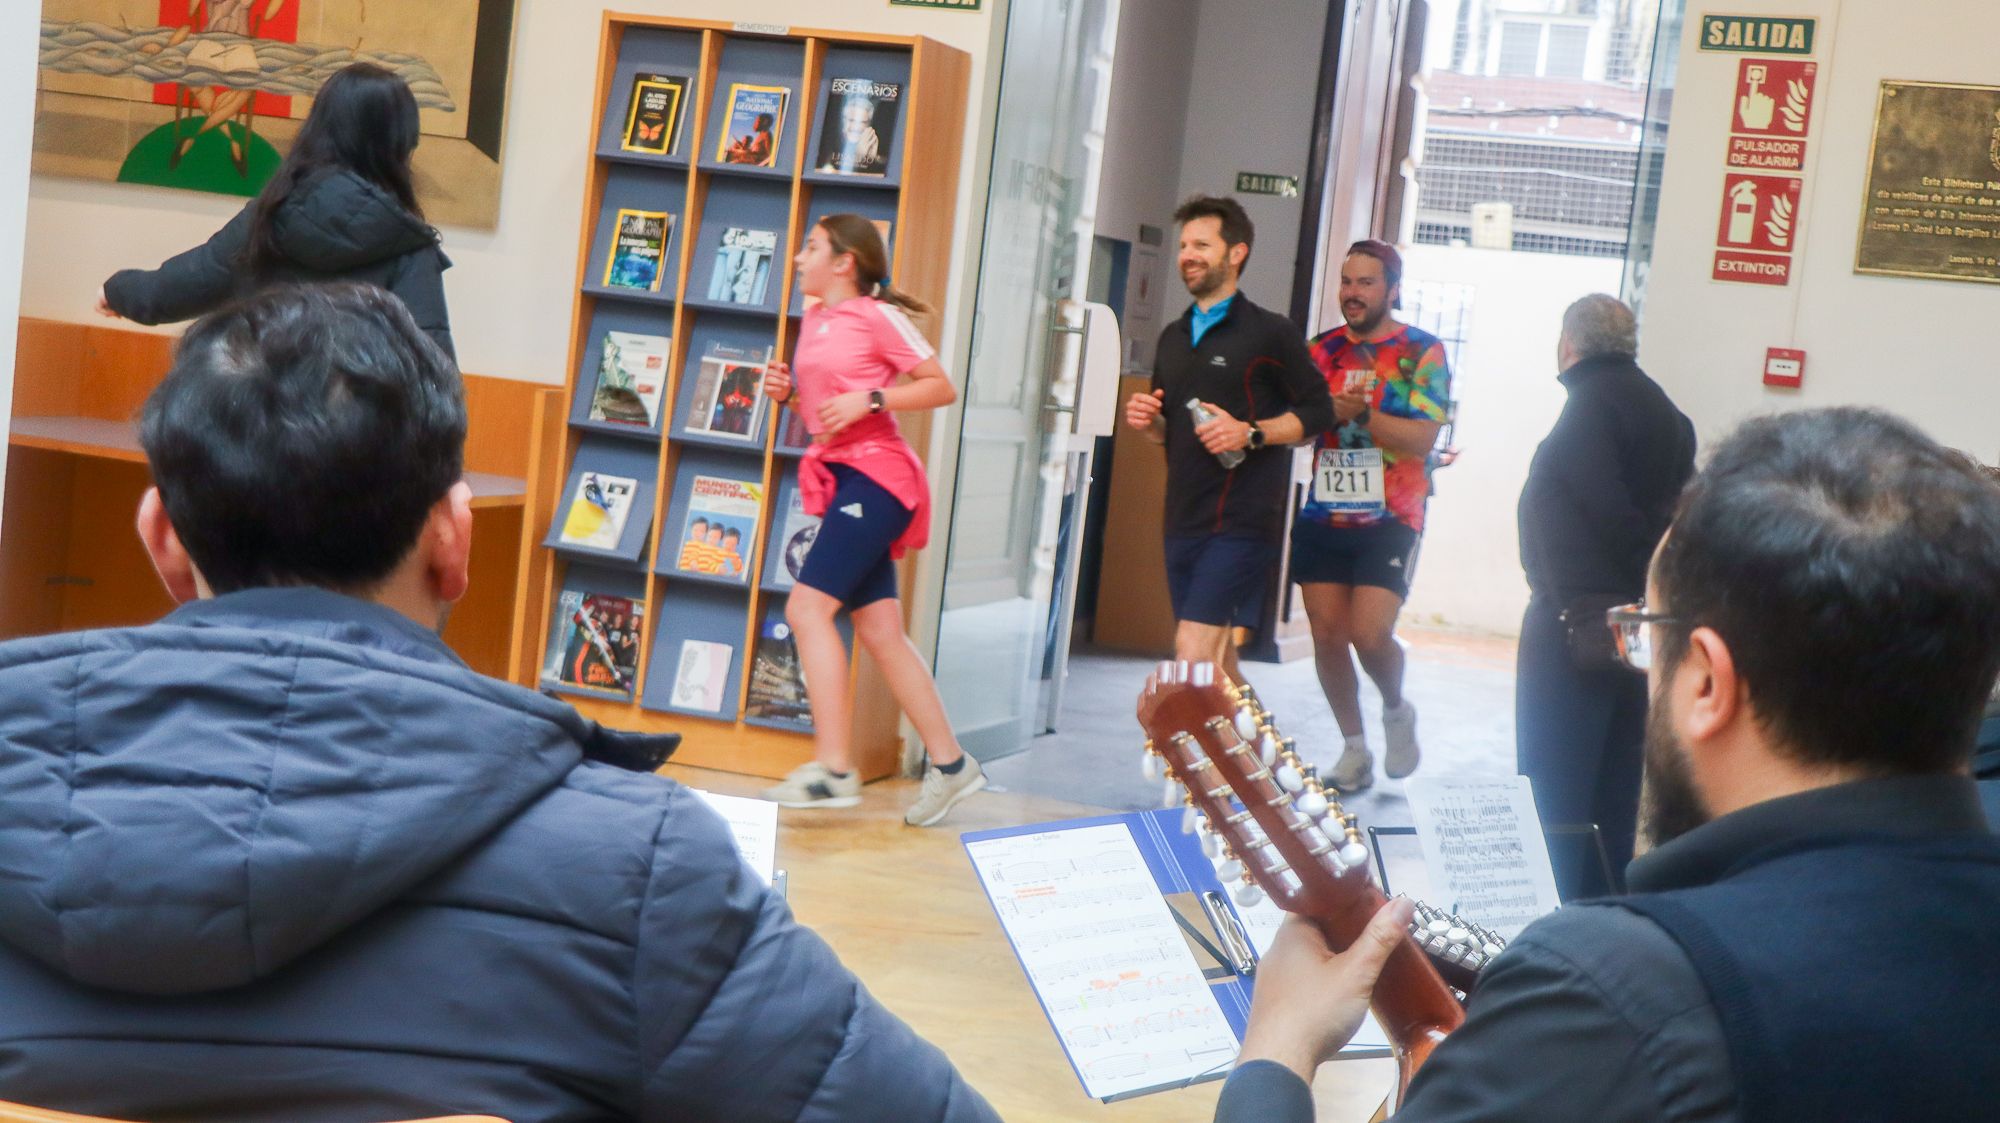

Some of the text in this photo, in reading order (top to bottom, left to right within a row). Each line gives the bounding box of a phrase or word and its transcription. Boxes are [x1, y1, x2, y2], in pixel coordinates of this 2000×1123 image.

[737, 22, 787, 33] HEMEROTECA
[1708, 20, 1805, 49] SALIDA
[832, 81, 898, 98] ESCENARIOS
[735, 101, 777, 113] GEOGRAPHIC
[746, 96, 773, 105] NATIONAL
[1734, 139, 1800, 154] PULSADOR
[1730, 152, 1799, 168] DE ALARMA
[1241, 175, 1293, 193] SALIDA
[1717, 259, 1787, 276] EXTINTOR
[695, 478, 742, 491] MUNDO
[1324, 469, 1370, 493] 1211
